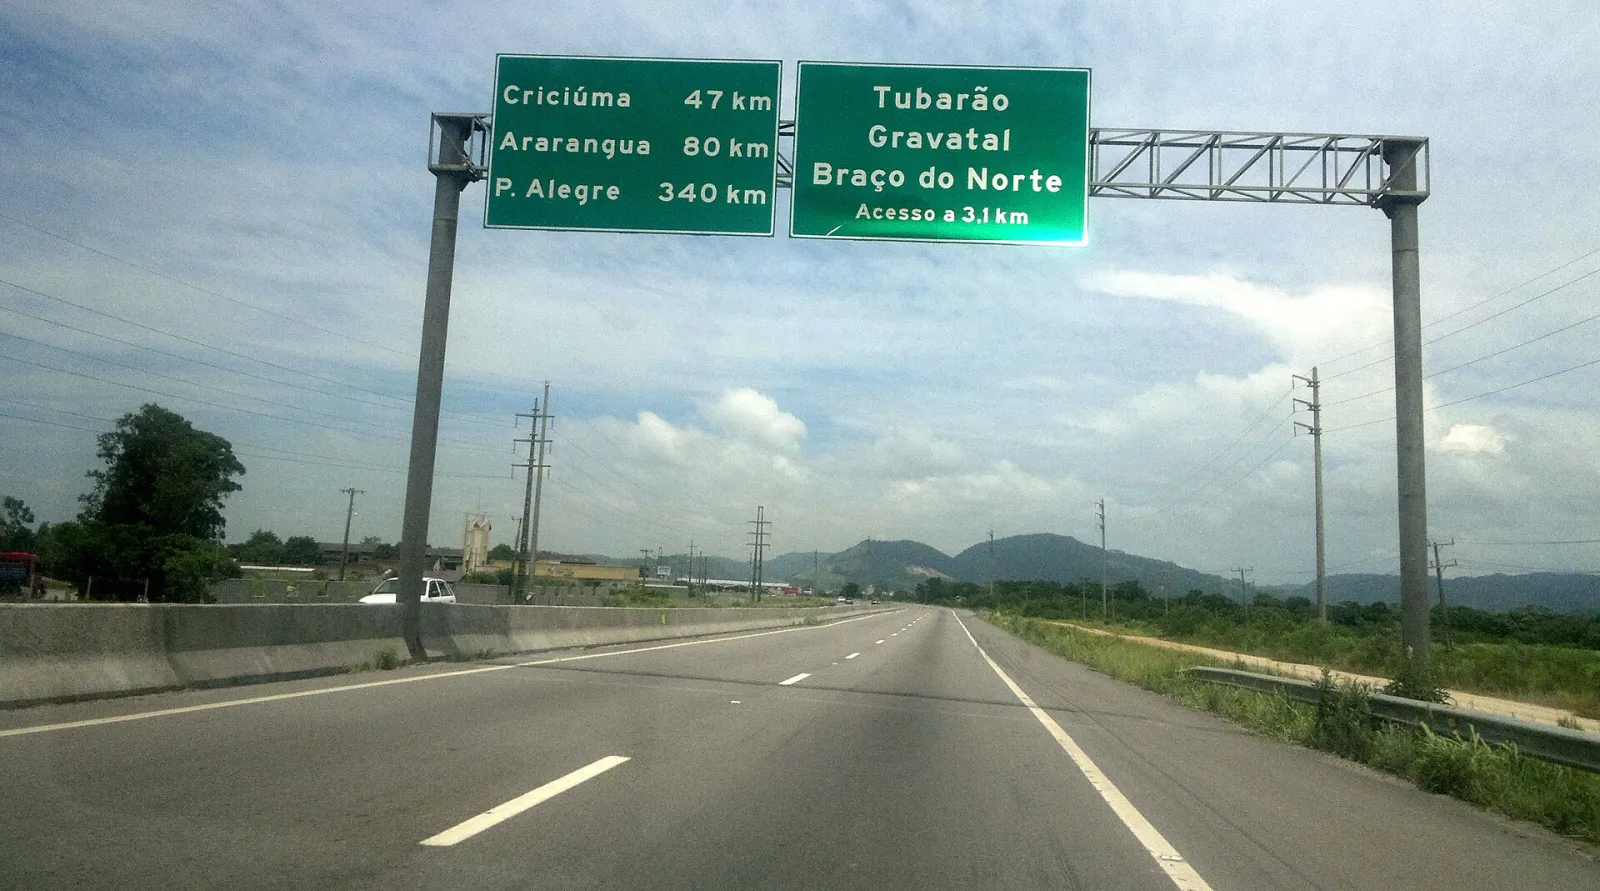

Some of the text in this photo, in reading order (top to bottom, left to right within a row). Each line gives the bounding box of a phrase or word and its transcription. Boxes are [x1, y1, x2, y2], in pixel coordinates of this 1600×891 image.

[503, 84, 771, 112] Criciúma 47 km
[873, 85, 1009, 112] Tubarão
[499, 131, 769, 160] Ararangua 80 km
[868, 124, 1010, 151] Gravatal
[495, 177, 766, 206] P. Alegre 340 km
[813, 162, 1063, 193] Braço do Norte
[855, 203, 936, 222] Acesso
[943, 209, 955, 223] a
[995, 207, 1029, 225] km
